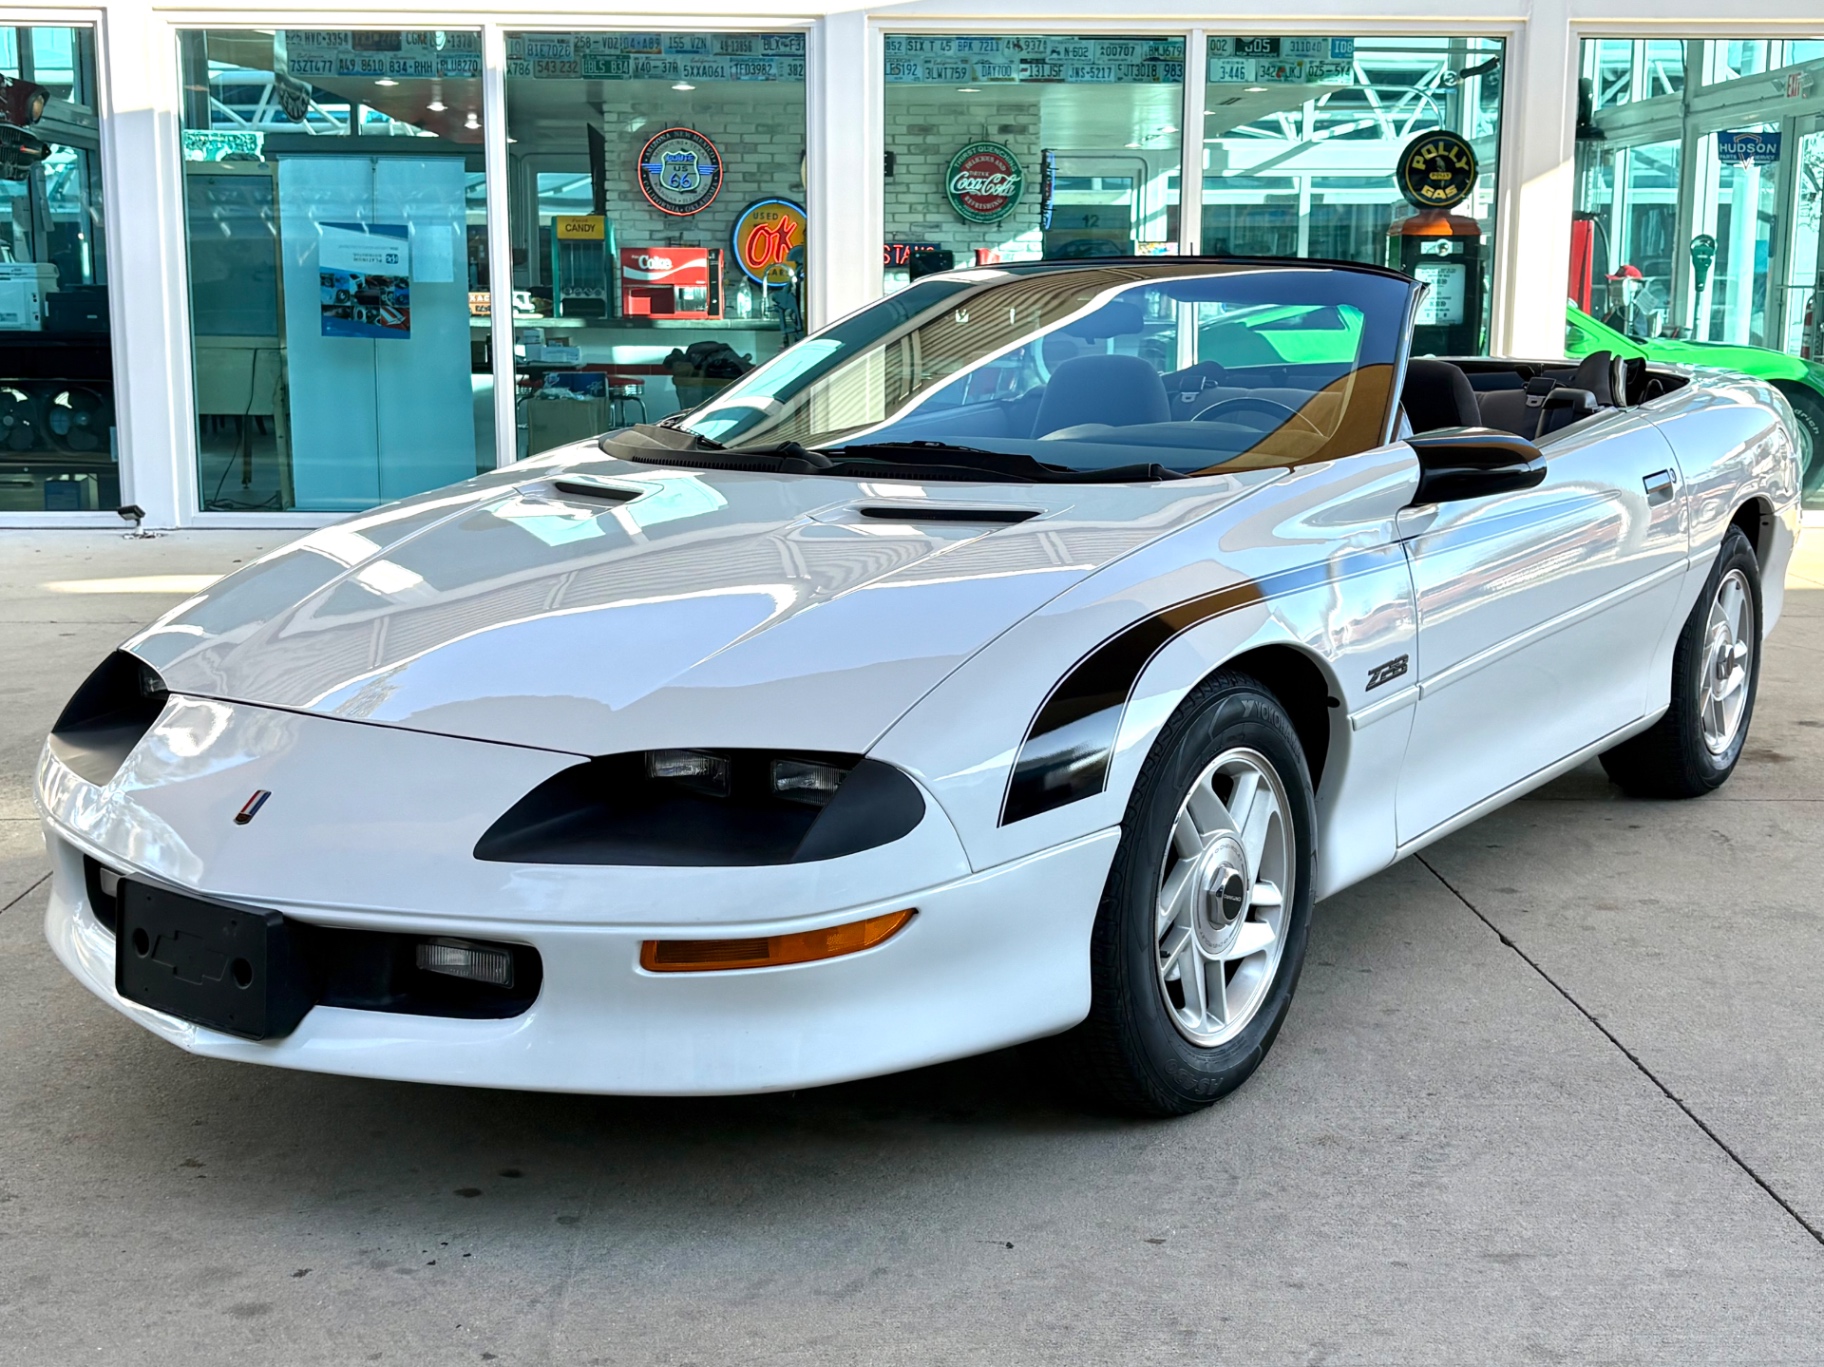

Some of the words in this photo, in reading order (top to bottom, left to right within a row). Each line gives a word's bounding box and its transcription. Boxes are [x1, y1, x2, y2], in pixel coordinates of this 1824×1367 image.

[1163, 63, 1183, 78] 983
[1719, 142, 1777, 154] HUDSON
[953, 147, 977, 168] THIRST
[977, 145, 1018, 172] QUENCHING
[1411, 141, 1470, 171] POLLY
[669, 172, 693, 189] 66
[1421, 184, 1458, 199] GAS
[752, 212, 779, 221] USED
[1082, 214, 1100, 228] 12
[565, 223, 596, 233] CANDY
[1365, 653, 1409, 692] Z28
